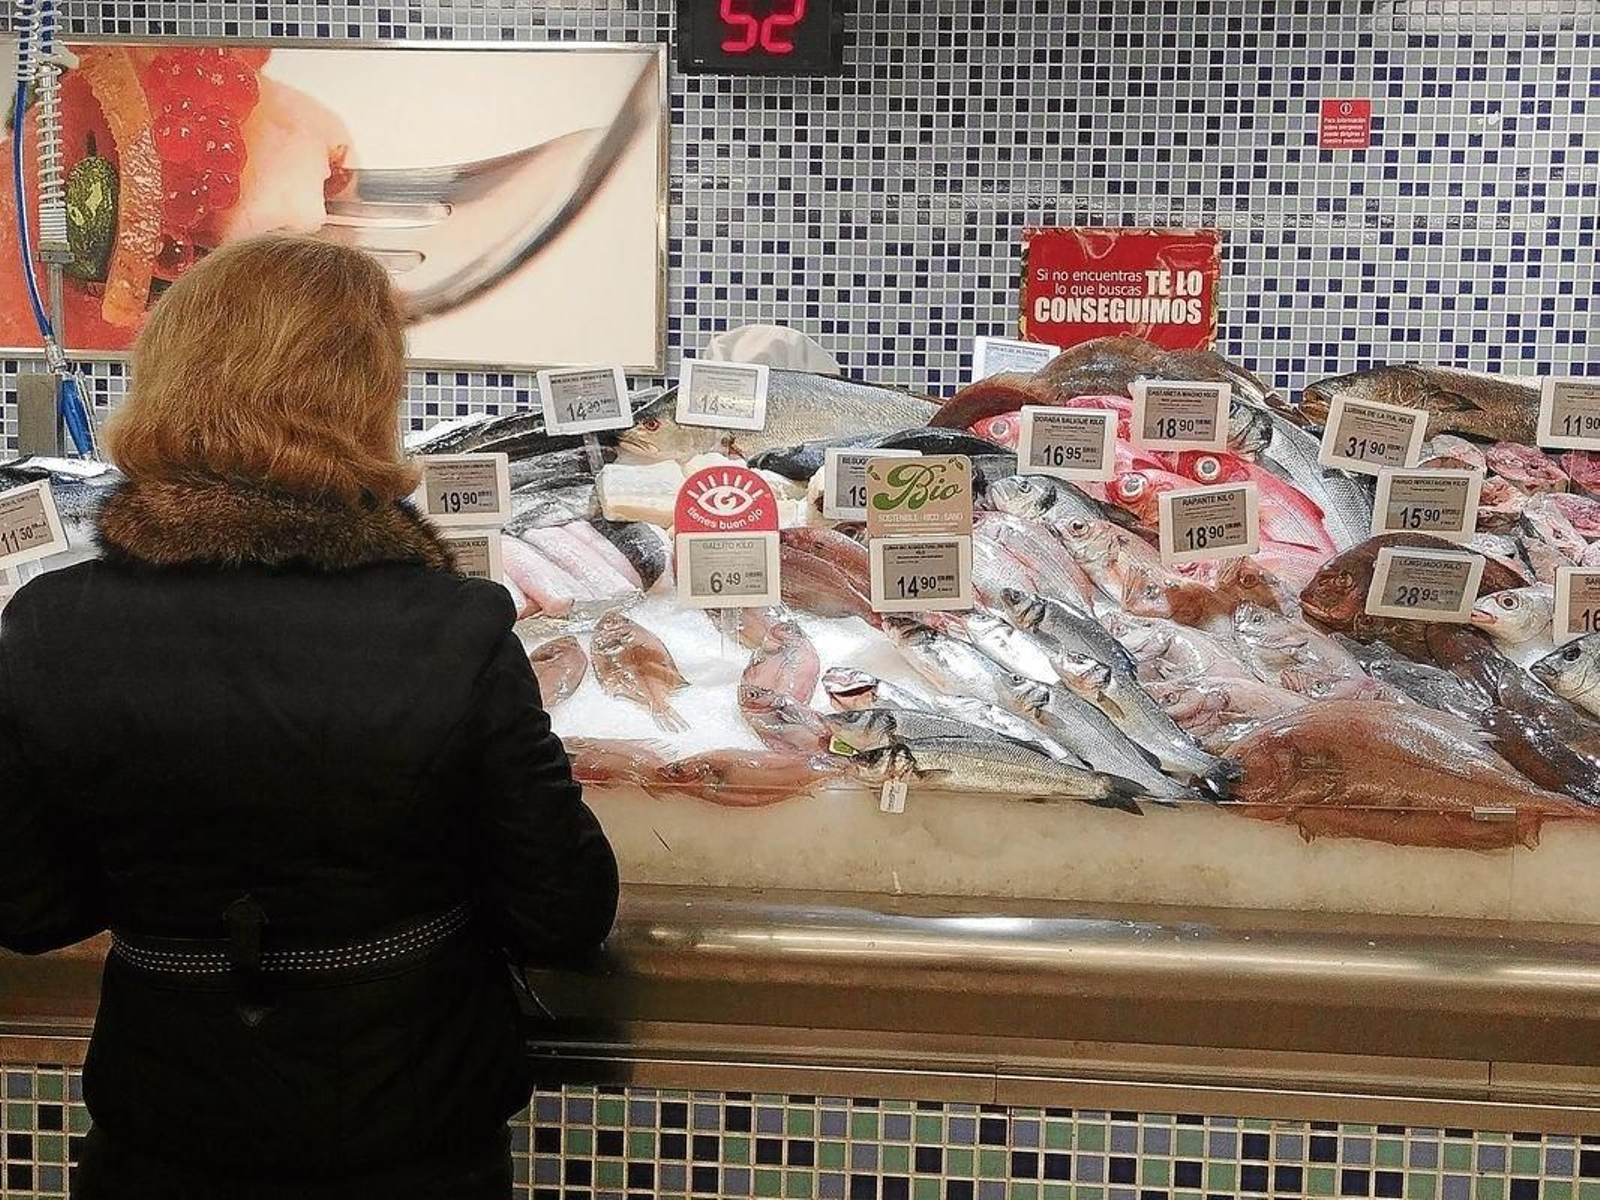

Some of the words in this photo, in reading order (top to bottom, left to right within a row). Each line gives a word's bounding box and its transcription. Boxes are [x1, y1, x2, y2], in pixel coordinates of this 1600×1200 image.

[721, 0, 806, 51] 52
[1037, 268, 1048, 281] Si
[1052, 271, 1068, 282] no
[1072, 270, 1142, 282] encuentras
[1145, 270, 1172, 296] TE
[1176, 271, 1202, 296] LO
[1055, 283, 1066, 295] lo
[1071, 286, 1094, 297] que
[1098, 283, 1142, 296] buscas
[1034, 297, 1202, 324] CONSEGUIMOS
[872, 464, 963, 510] Bio
[687, 506, 717, 528] tienes
[720, 518, 747, 530] buen
[748, 508, 763, 523] ojo
